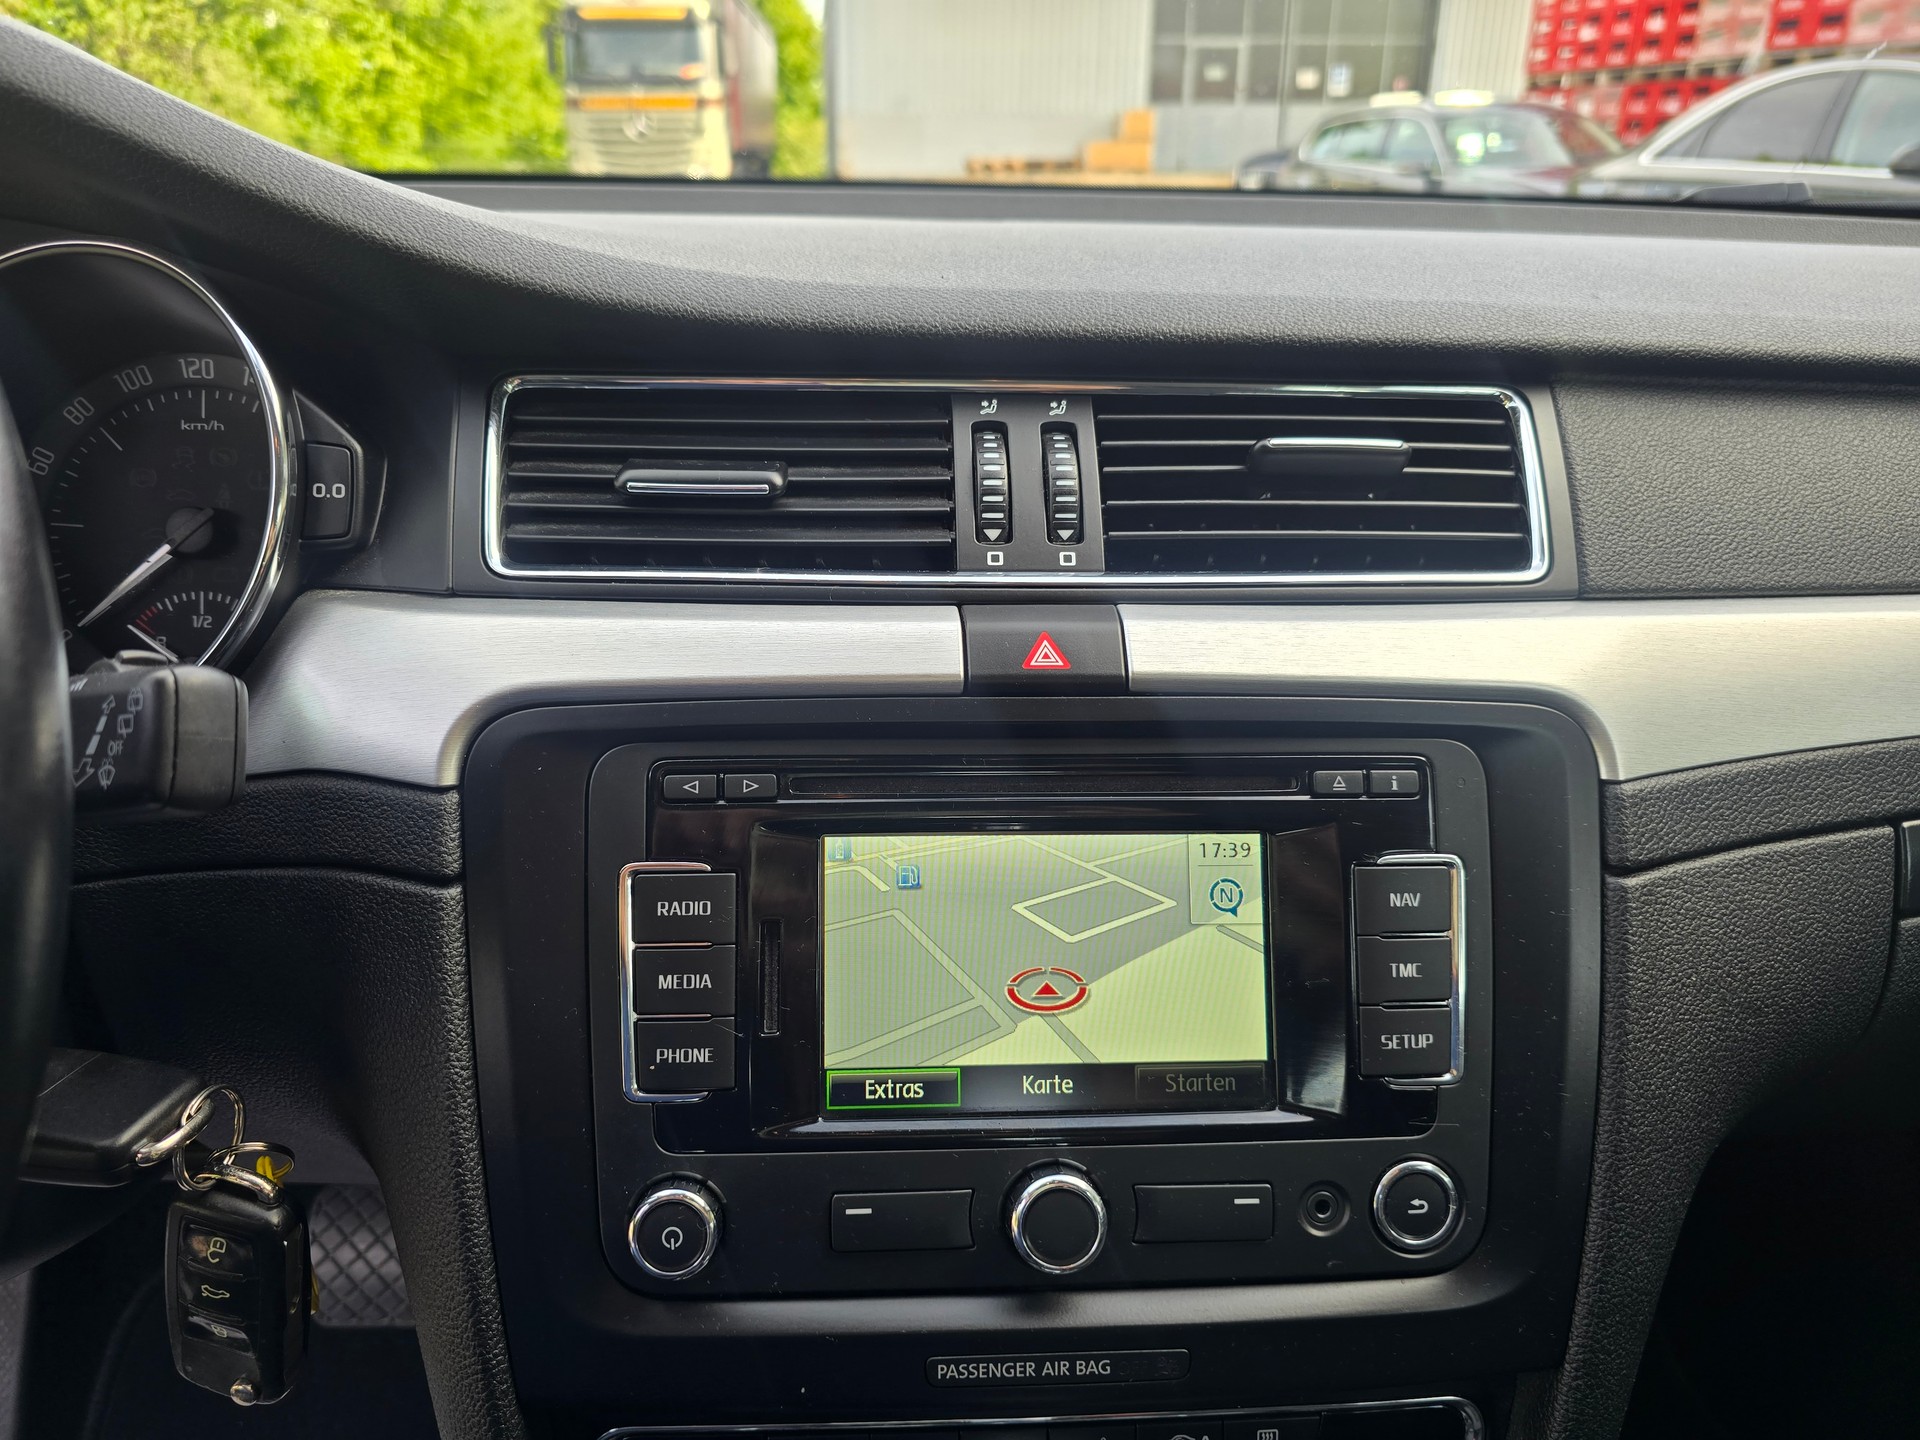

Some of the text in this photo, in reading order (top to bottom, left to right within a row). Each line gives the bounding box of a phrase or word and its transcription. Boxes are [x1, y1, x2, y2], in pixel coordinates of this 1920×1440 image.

[178, 358, 215, 379] 120
[113, 365, 153, 393] 100
[63, 396, 95, 425] 80
[181, 419, 225, 431] km/h
[26, 446, 55, 476] 60
[312, 483, 346, 499] 0.0
[192, 615, 213, 628] 1/2
[107, 740, 124, 756] OFF
[1199, 842, 1251, 858] 17:39
[1219, 887, 1233, 903] N
[1389, 892, 1421, 907] NAV
[657, 900, 711, 916] RADIO
[1389, 963, 1423, 978] TMC
[658, 974, 712, 989] MEDIA
[1381, 1033, 1434, 1049] SETUP
[656, 1048, 714, 1063] PHONE
[865, 1078, 925, 1100] Extras
[1022, 1075, 1074, 1095] Karte
[1165, 1073, 1236, 1092] Starten
[937, 1361, 1036, 1379] PASSENGER
[1041, 1360, 1071, 1377] AIR
[1076, 1359, 1111, 1376] BAG
